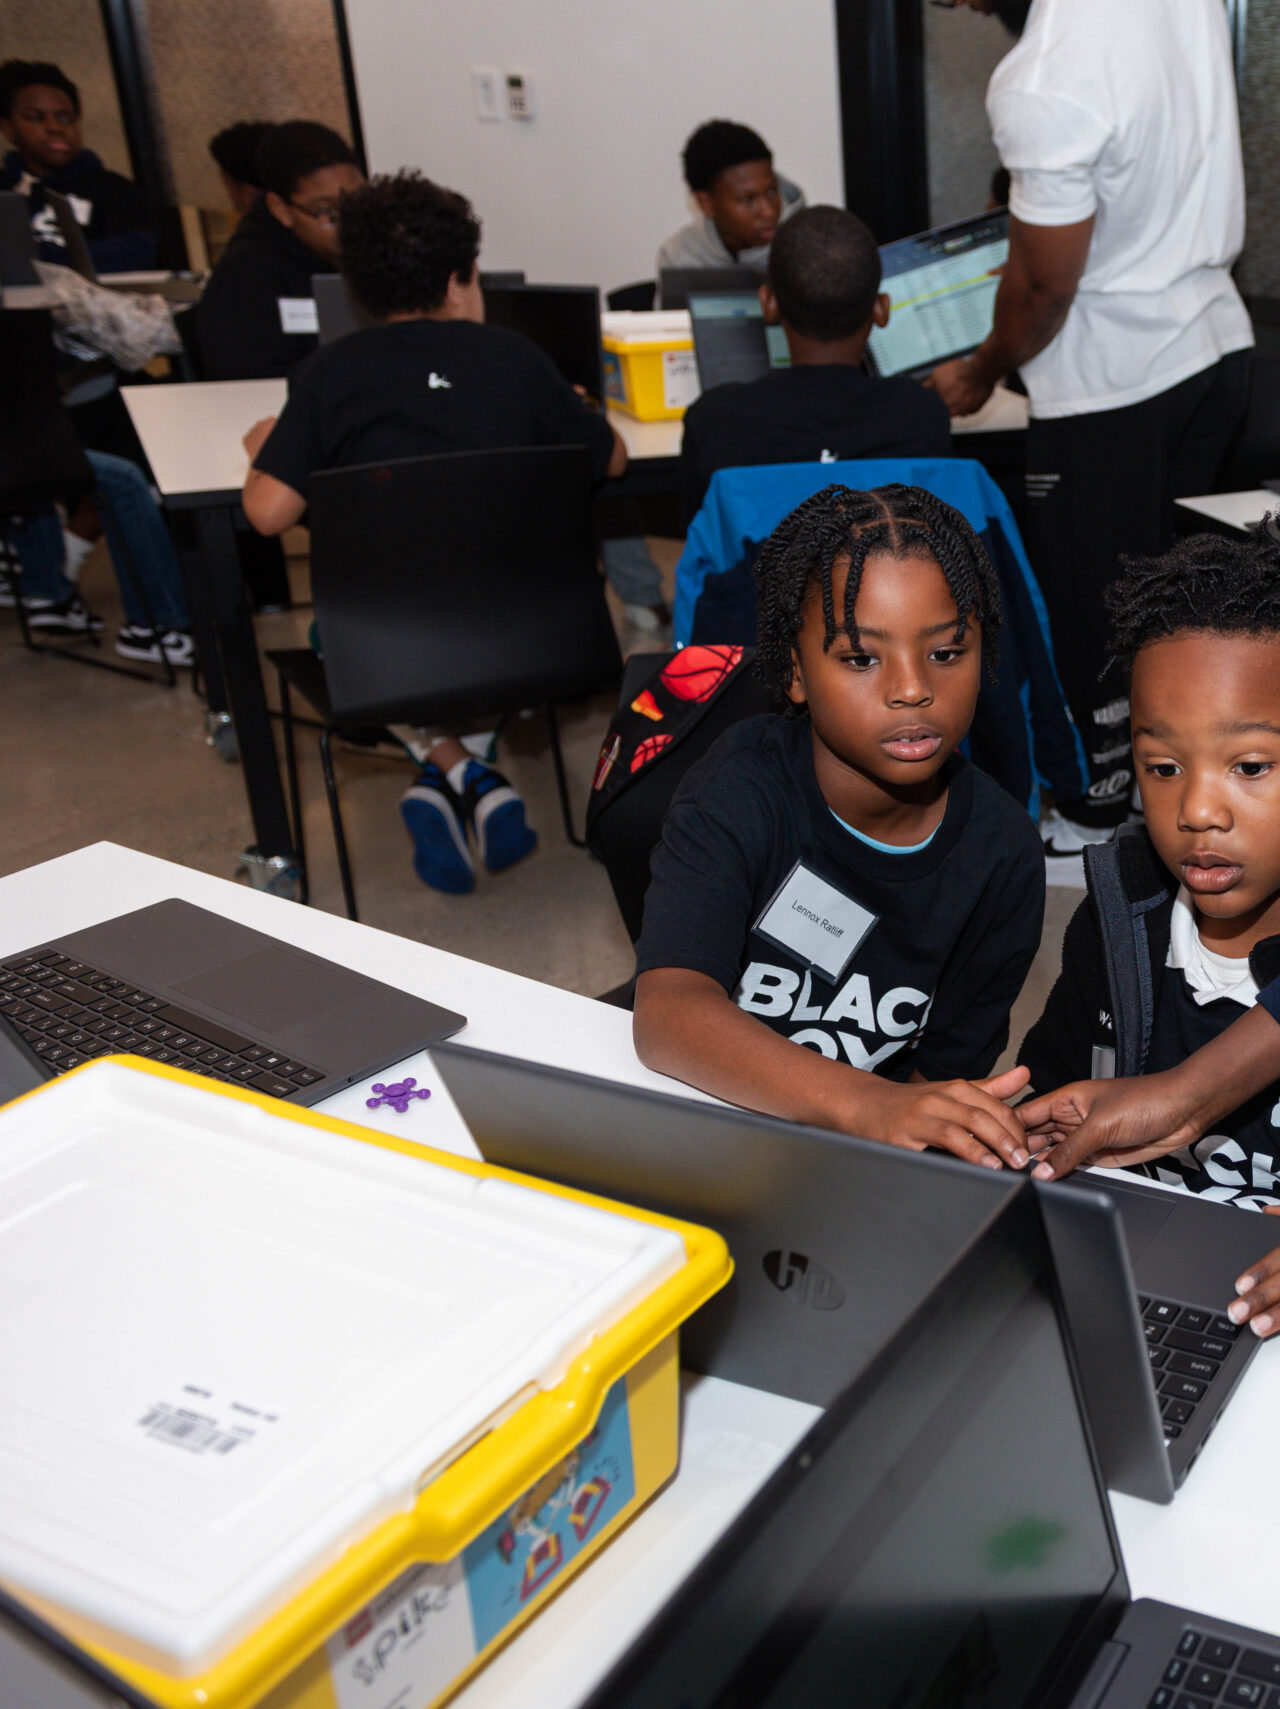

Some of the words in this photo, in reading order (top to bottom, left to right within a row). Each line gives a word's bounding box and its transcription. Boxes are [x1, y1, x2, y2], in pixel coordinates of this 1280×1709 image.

[791, 899, 821, 924] Lennox
[820, 918, 845, 939] Ratliff
[739, 961, 936, 1038] BLAC
